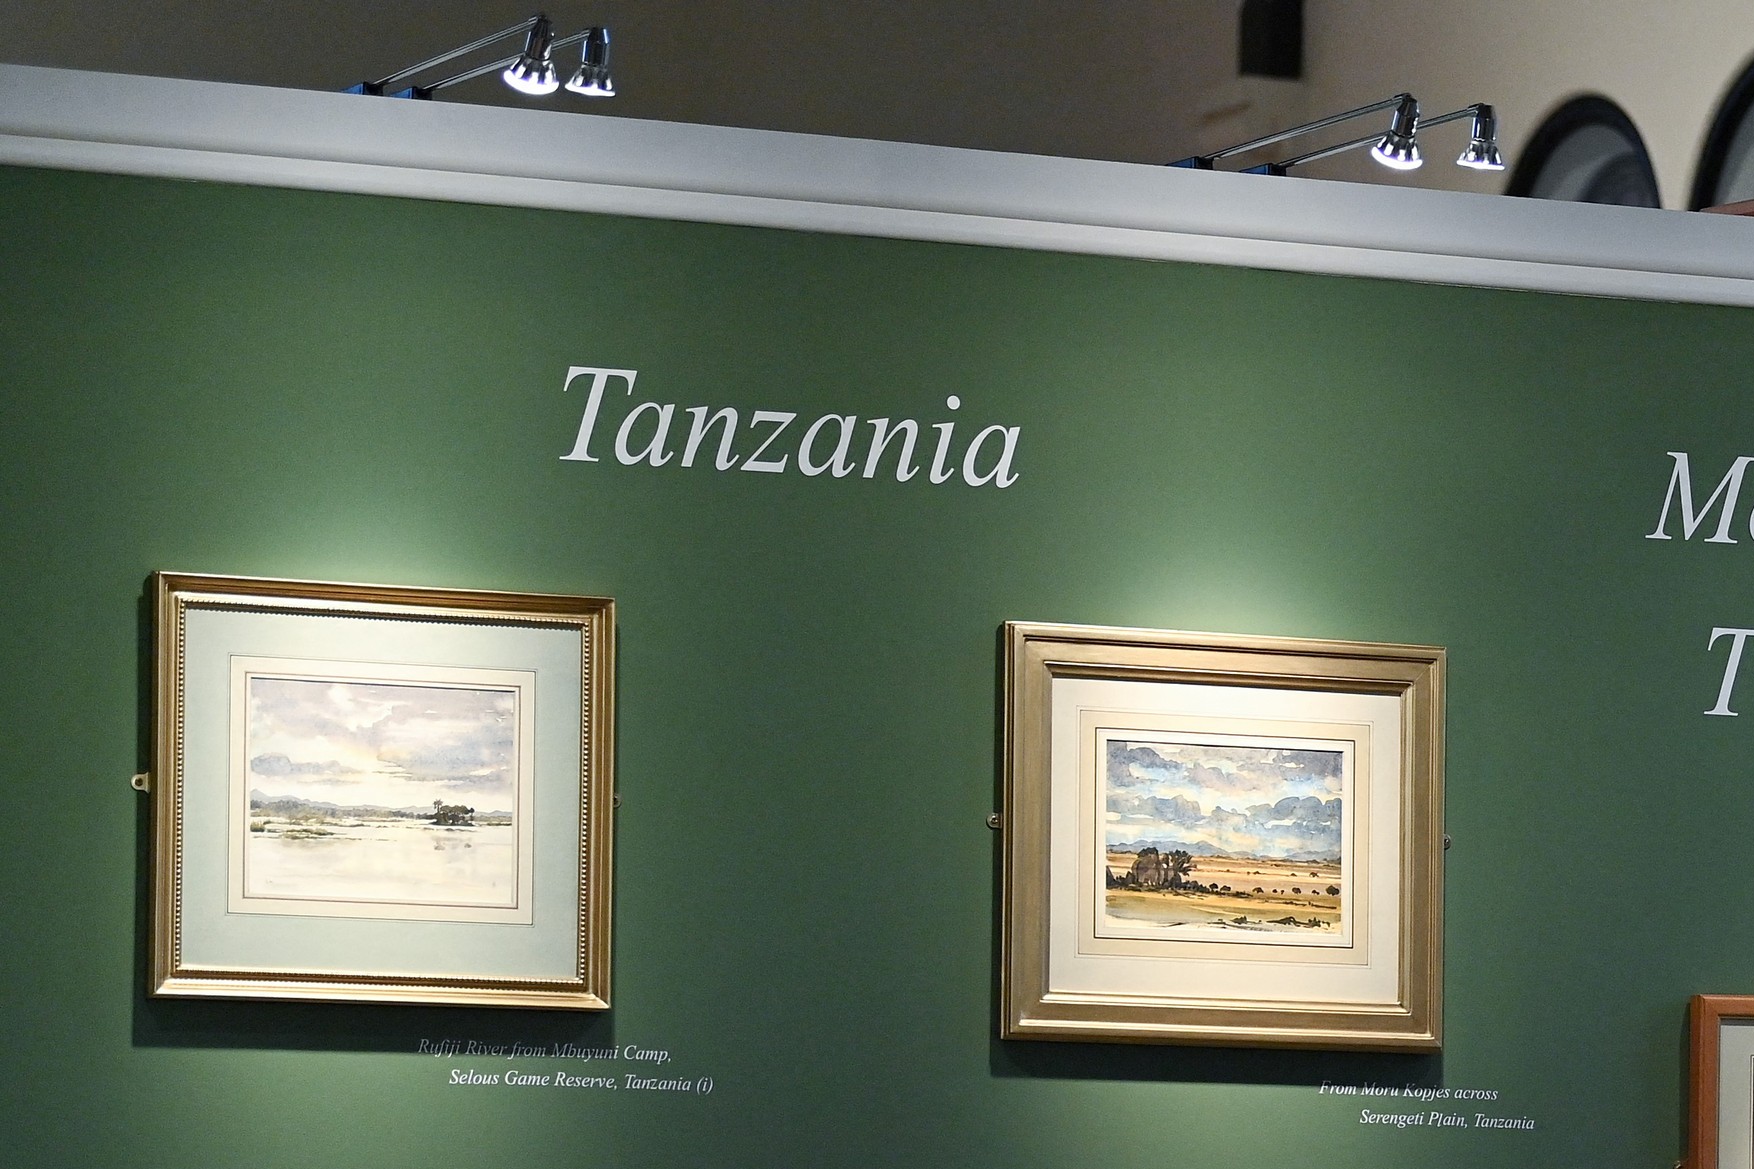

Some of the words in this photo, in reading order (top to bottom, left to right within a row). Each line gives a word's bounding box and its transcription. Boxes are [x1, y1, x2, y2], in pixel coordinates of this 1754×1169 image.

[559, 365, 1021, 489] Tanzania
[417, 1038, 462, 1058] Rufiji
[465, 1040, 508, 1056] River
[507, 1041, 546, 1060] from
[550, 1043, 619, 1062] Mbuyuni
[623, 1044, 672, 1065] Camp,
[449, 1069, 499, 1086] Selous
[504, 1070, 550, 1087] Game
[553, 1071, 618, 1090] Reserve,
[624, 1073, 691, 1092] Tanzania
[696, 1076, 714, 1095] (i)
[1318, 1080, 1357, 1096] From
[1360, 1081, 1399, 1097] Moru
[1402, 1082, 1450, 1101] Kopjes
[1454, 1088, 1499, 1100] across
[1359, 1109, 1425, 1128] Serengeti
[1427, 1111, 1469, 1129] Plain,
[1474, 1113, 1535, 1130] Tanzania
